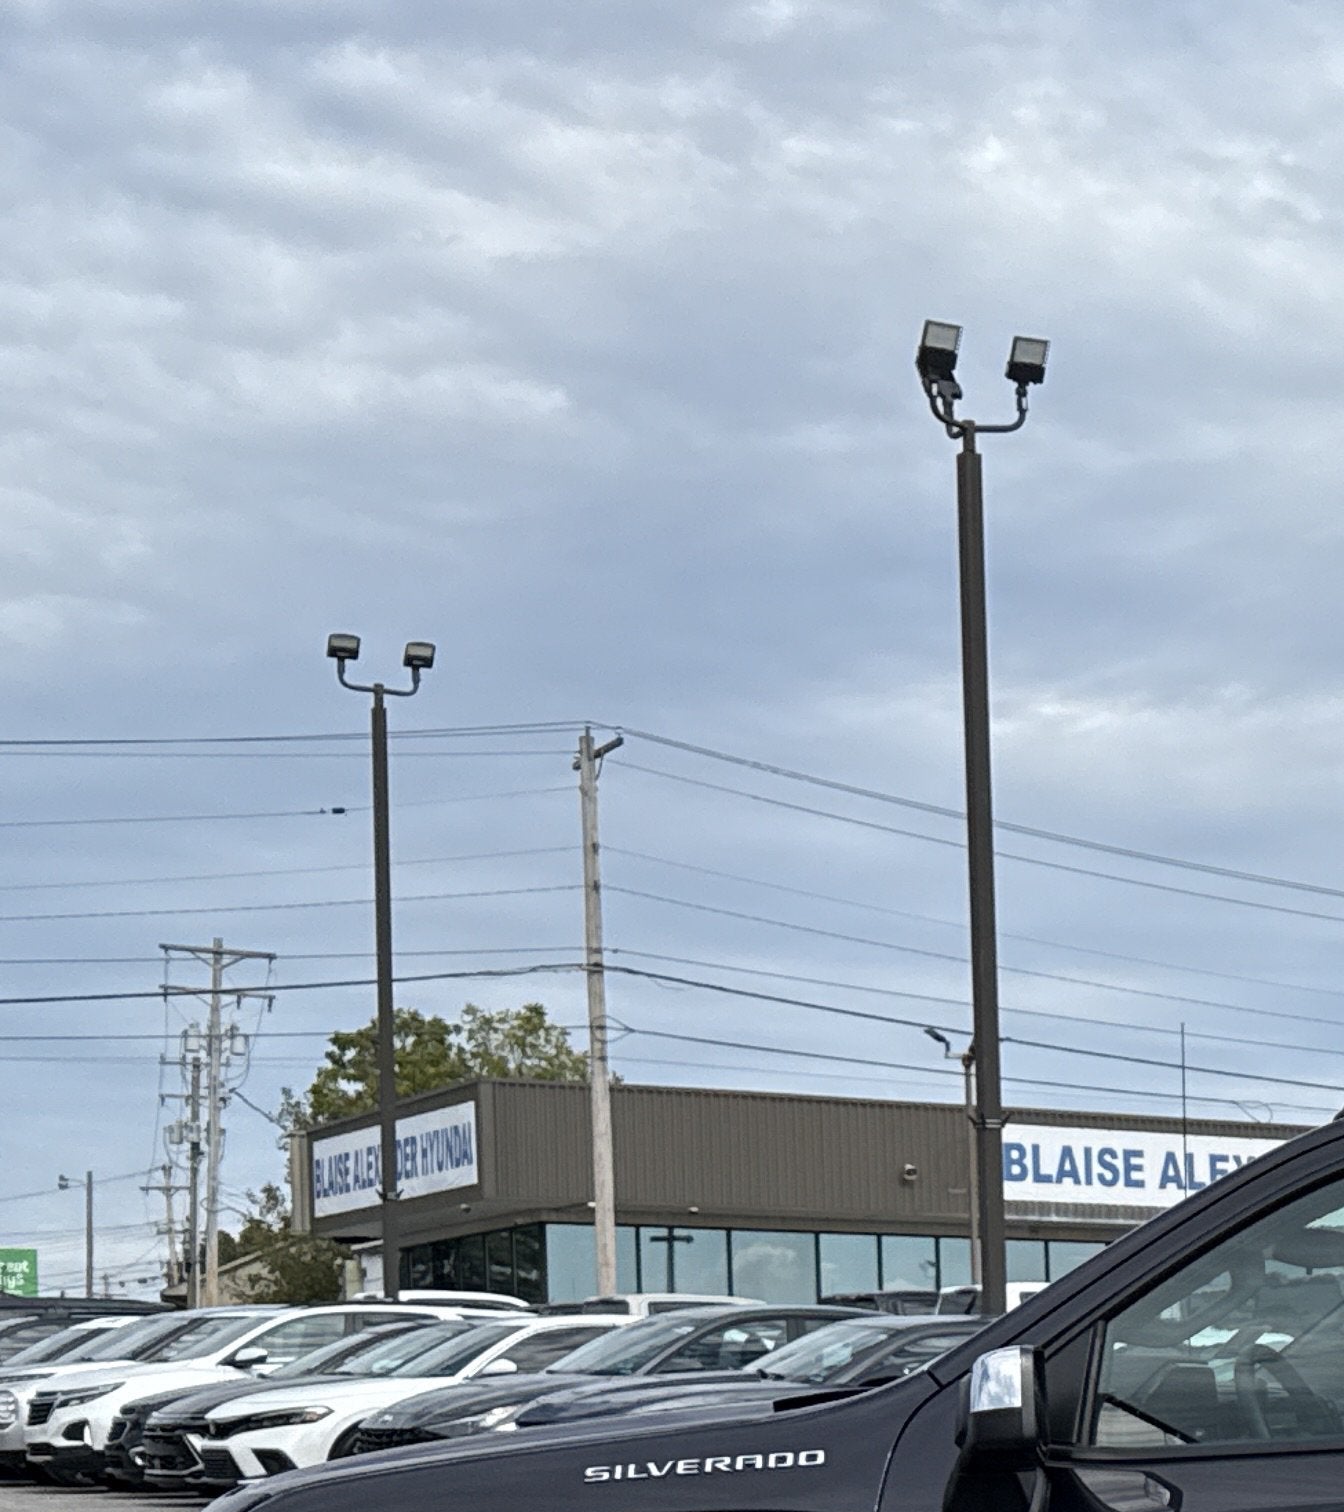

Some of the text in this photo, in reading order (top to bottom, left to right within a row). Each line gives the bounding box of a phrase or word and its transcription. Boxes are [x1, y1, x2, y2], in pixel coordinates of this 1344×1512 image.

[315, 1121, 474, 1199] BLAISE ALEXDER HYUNDAI
[1002, 1142, 1146, 1189] BLAISE
[583, 1449, 827, 1483] SILVERADO
